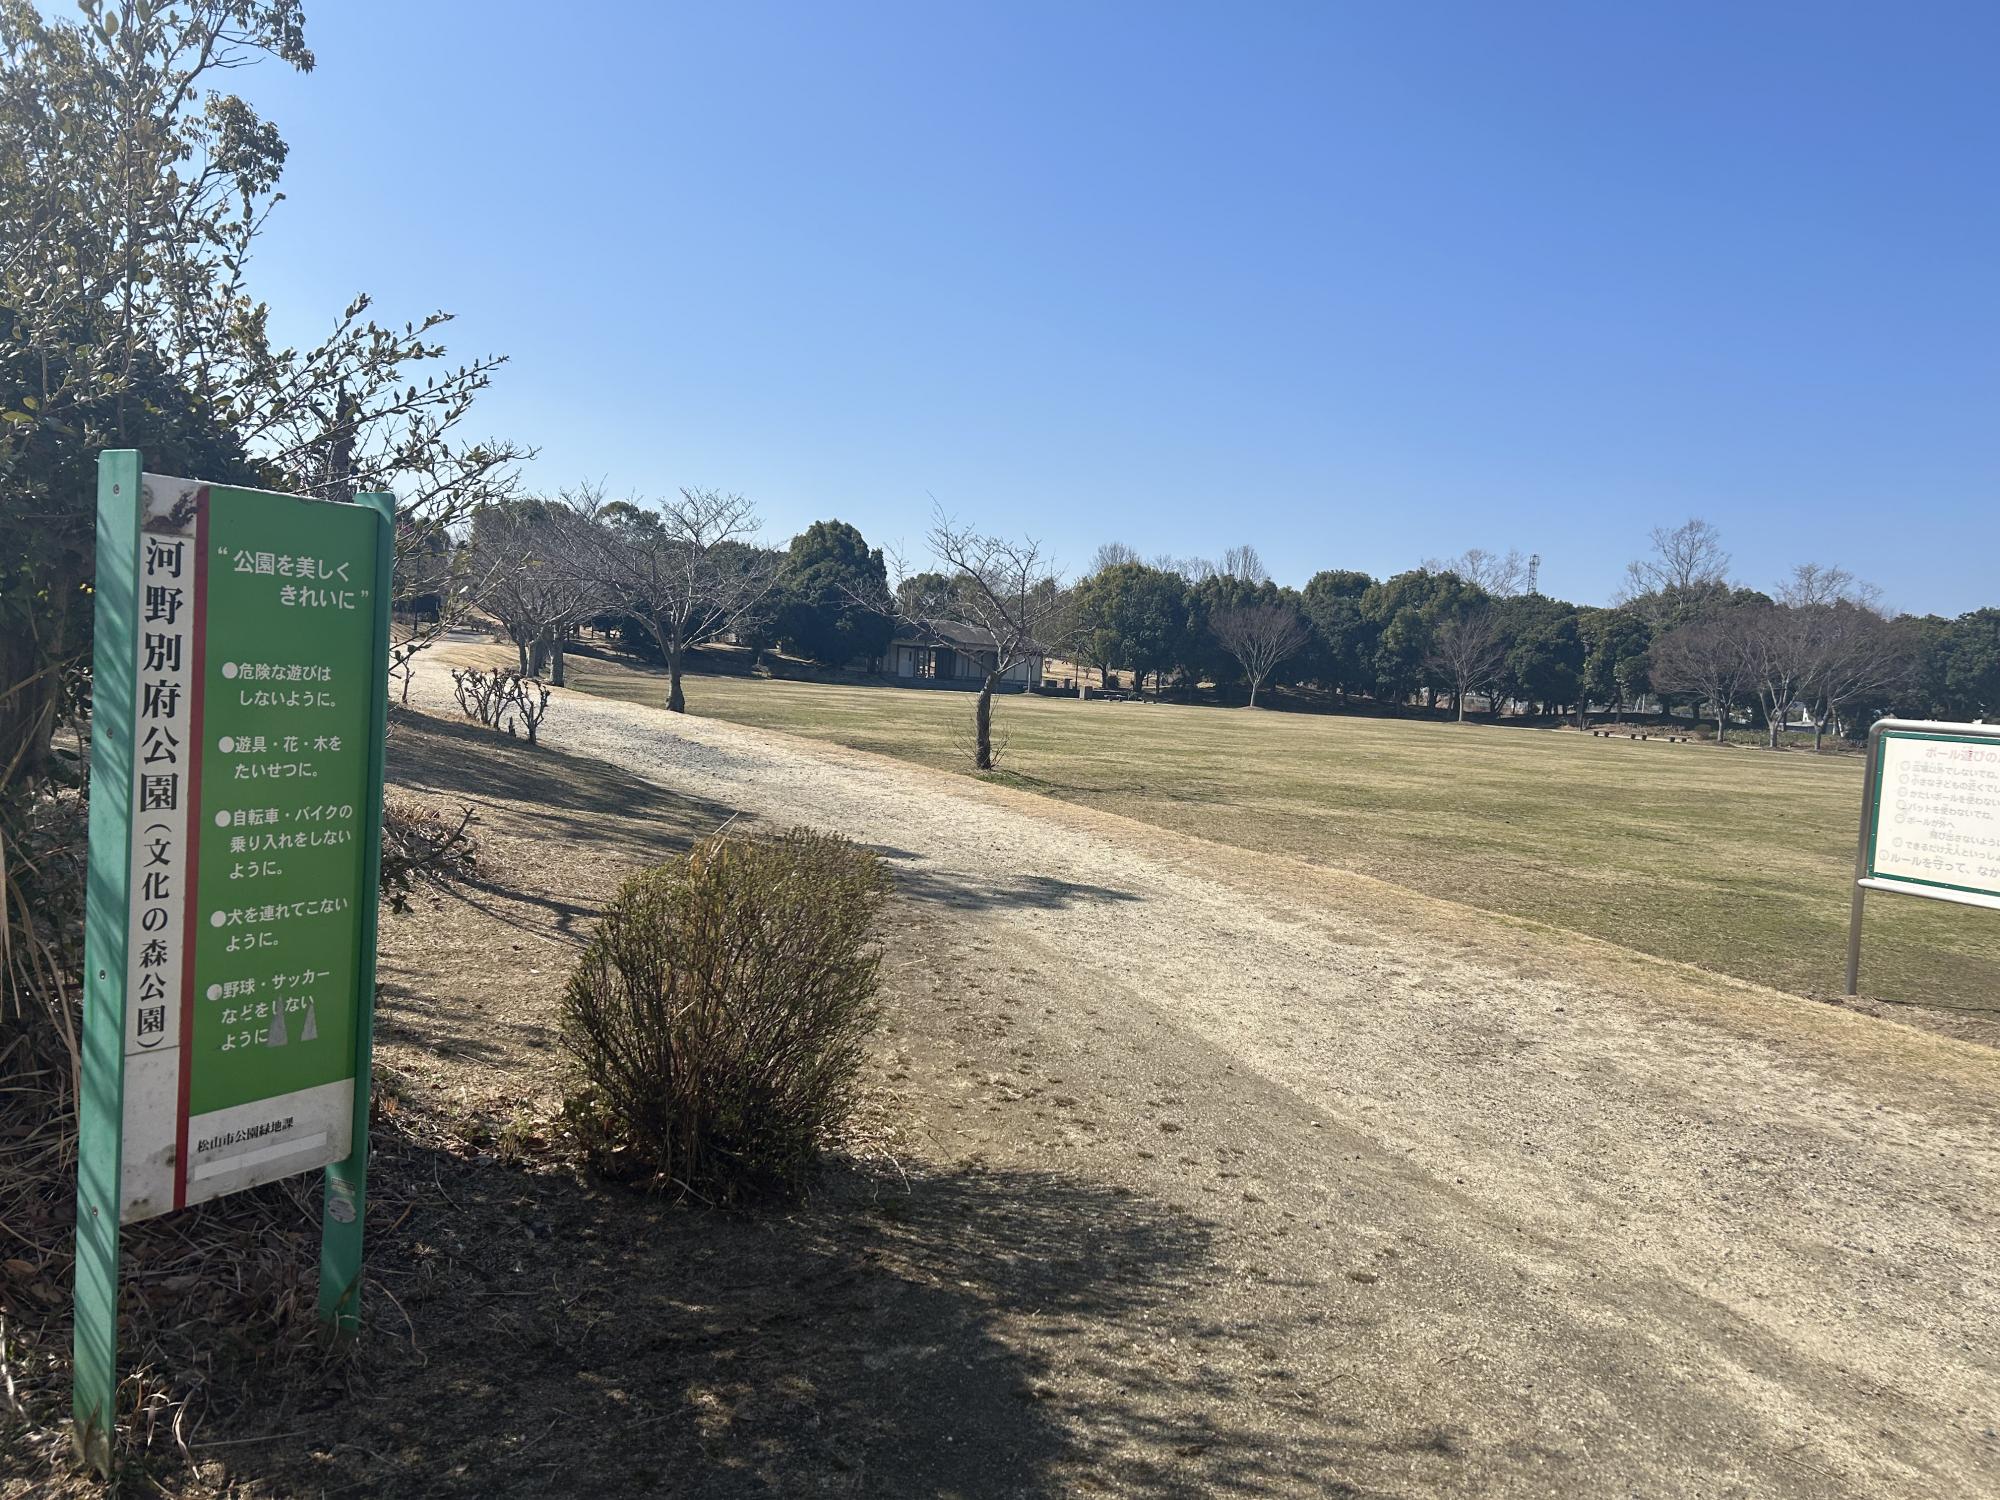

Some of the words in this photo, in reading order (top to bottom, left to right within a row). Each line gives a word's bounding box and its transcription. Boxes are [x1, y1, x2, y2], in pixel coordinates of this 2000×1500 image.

[240, 690, 336, 707] しないように。
[1925, 747, 2000, 763] ボール遊びの
[234, 763, 318, 779] たいせつに。
[230, 830, 351, 853] 乗り入れをしない
[229, 861, 283, 879] ように。
[226, 932, 279, 952] ように。
[221, 995, 314, 1024] などをしない
